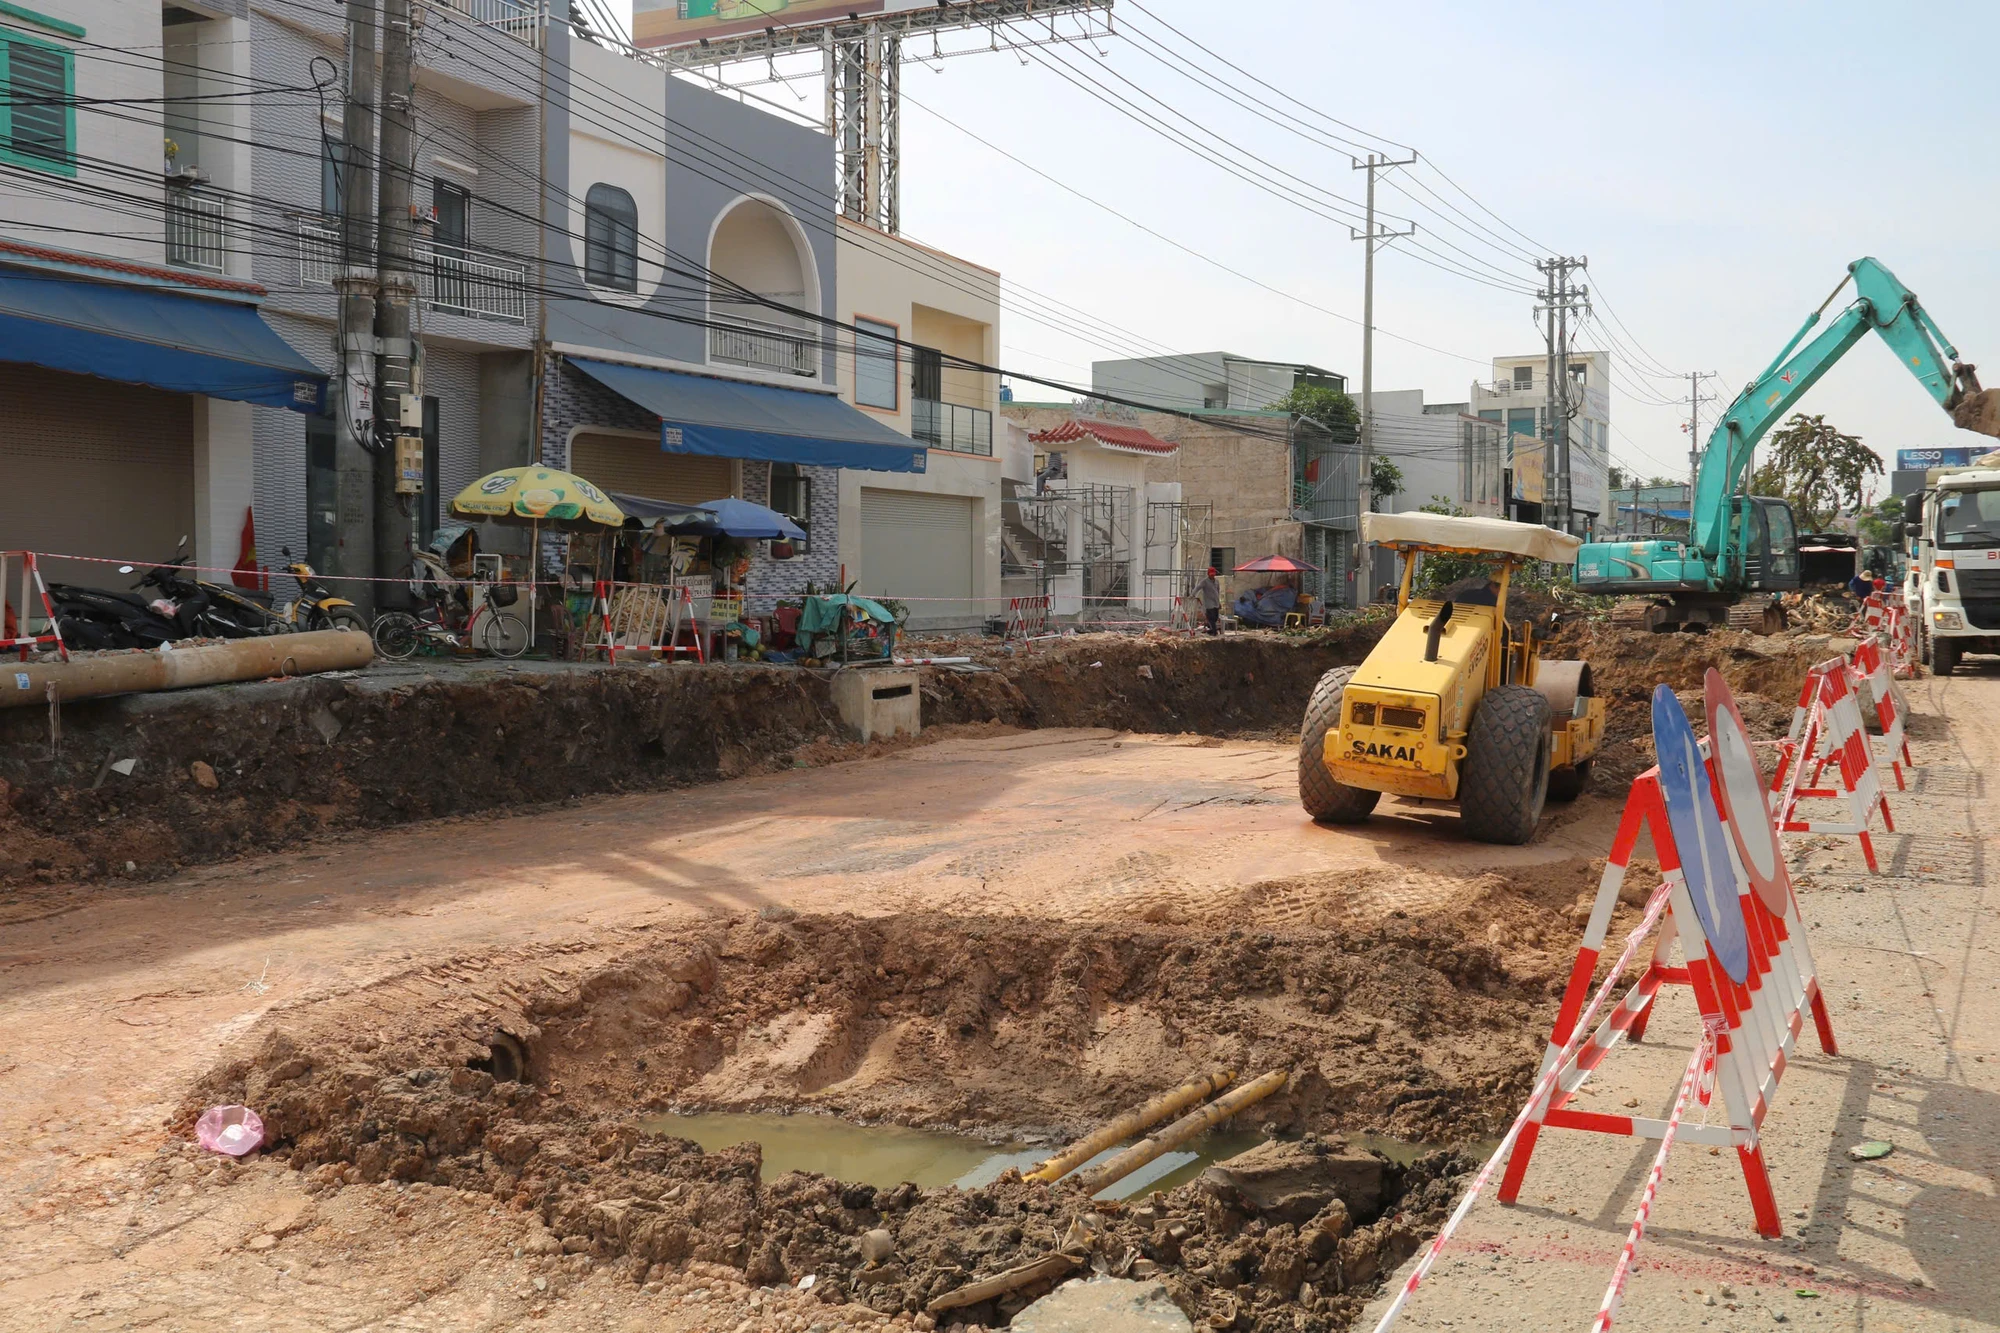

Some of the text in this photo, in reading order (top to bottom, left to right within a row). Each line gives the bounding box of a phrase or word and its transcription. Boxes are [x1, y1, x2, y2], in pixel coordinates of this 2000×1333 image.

[1903, 451, 1942, 460] LESSO
[481, 475, 518, 494] C2
[573, 480, 603, 503] C2
[1987, 551, 2000, 560] B
[1352, 741, 1415, 761] SAKAI
